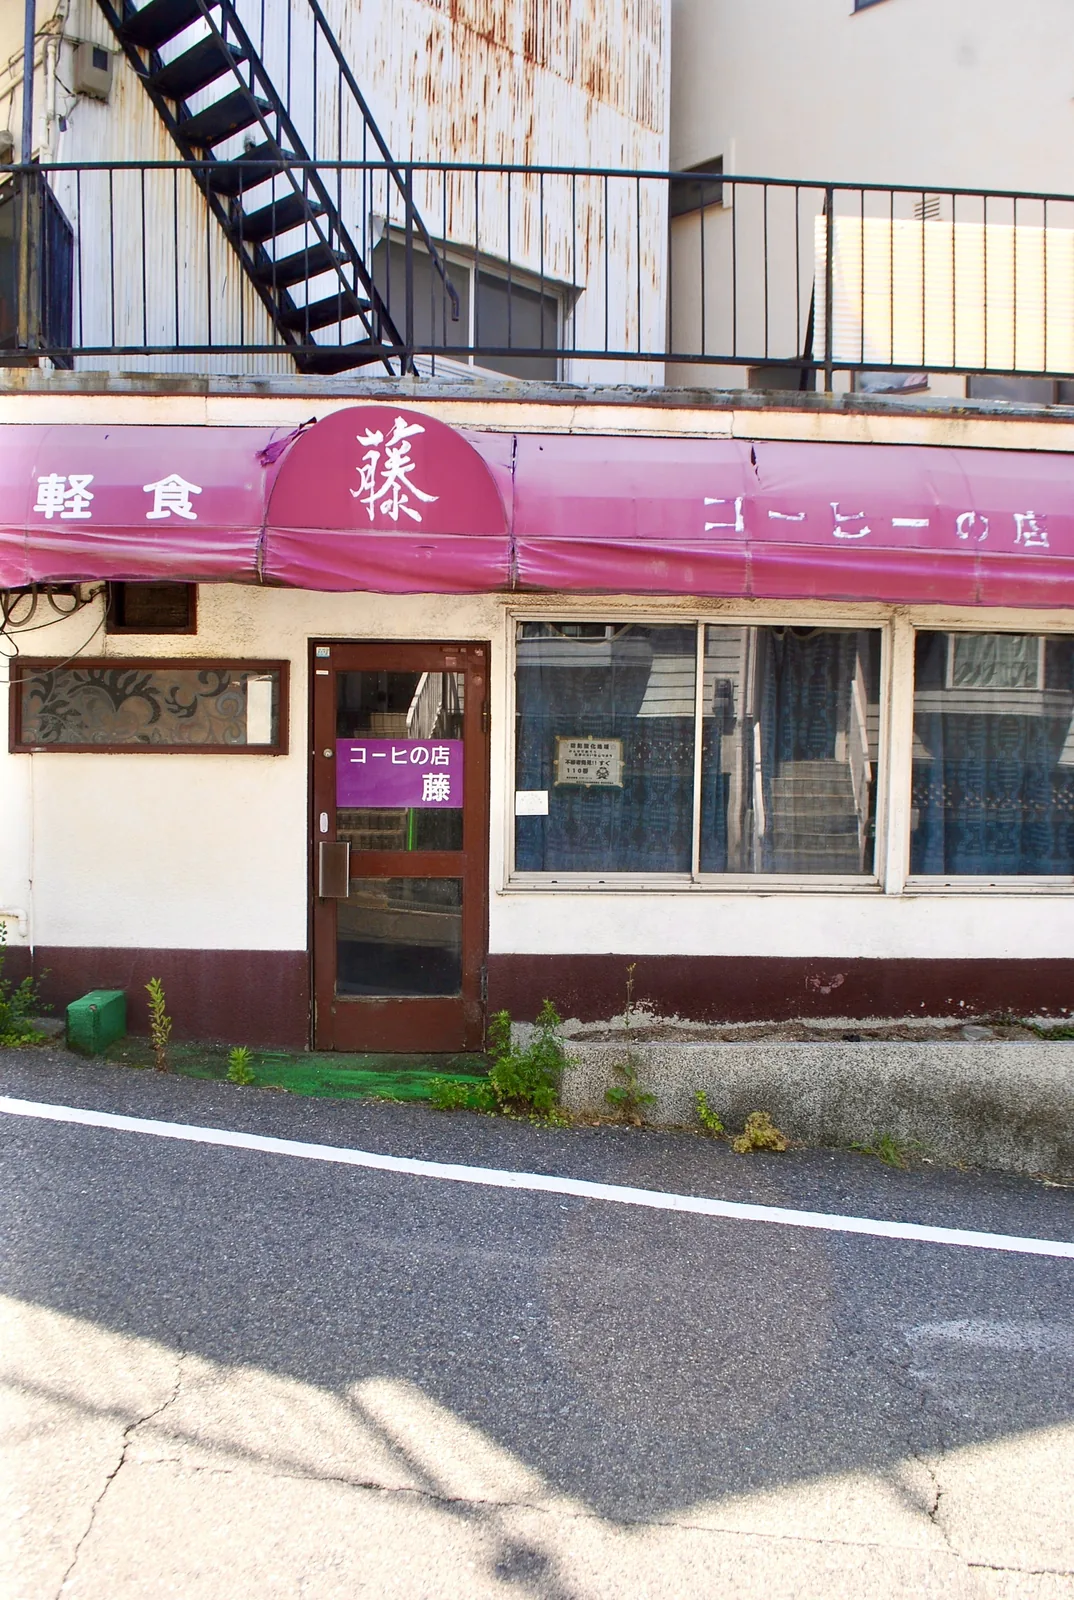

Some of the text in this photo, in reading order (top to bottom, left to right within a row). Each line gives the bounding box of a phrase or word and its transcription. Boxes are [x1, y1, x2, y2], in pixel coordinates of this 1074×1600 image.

[349, 416, 439, 523] 藤
[33, 472, 203, 520] 軽食
[703, 495, 1050, 549] コーヒーの店
[350, 746, 450, 765] コーヒの店
[422, 773, 450, 801] 藤
